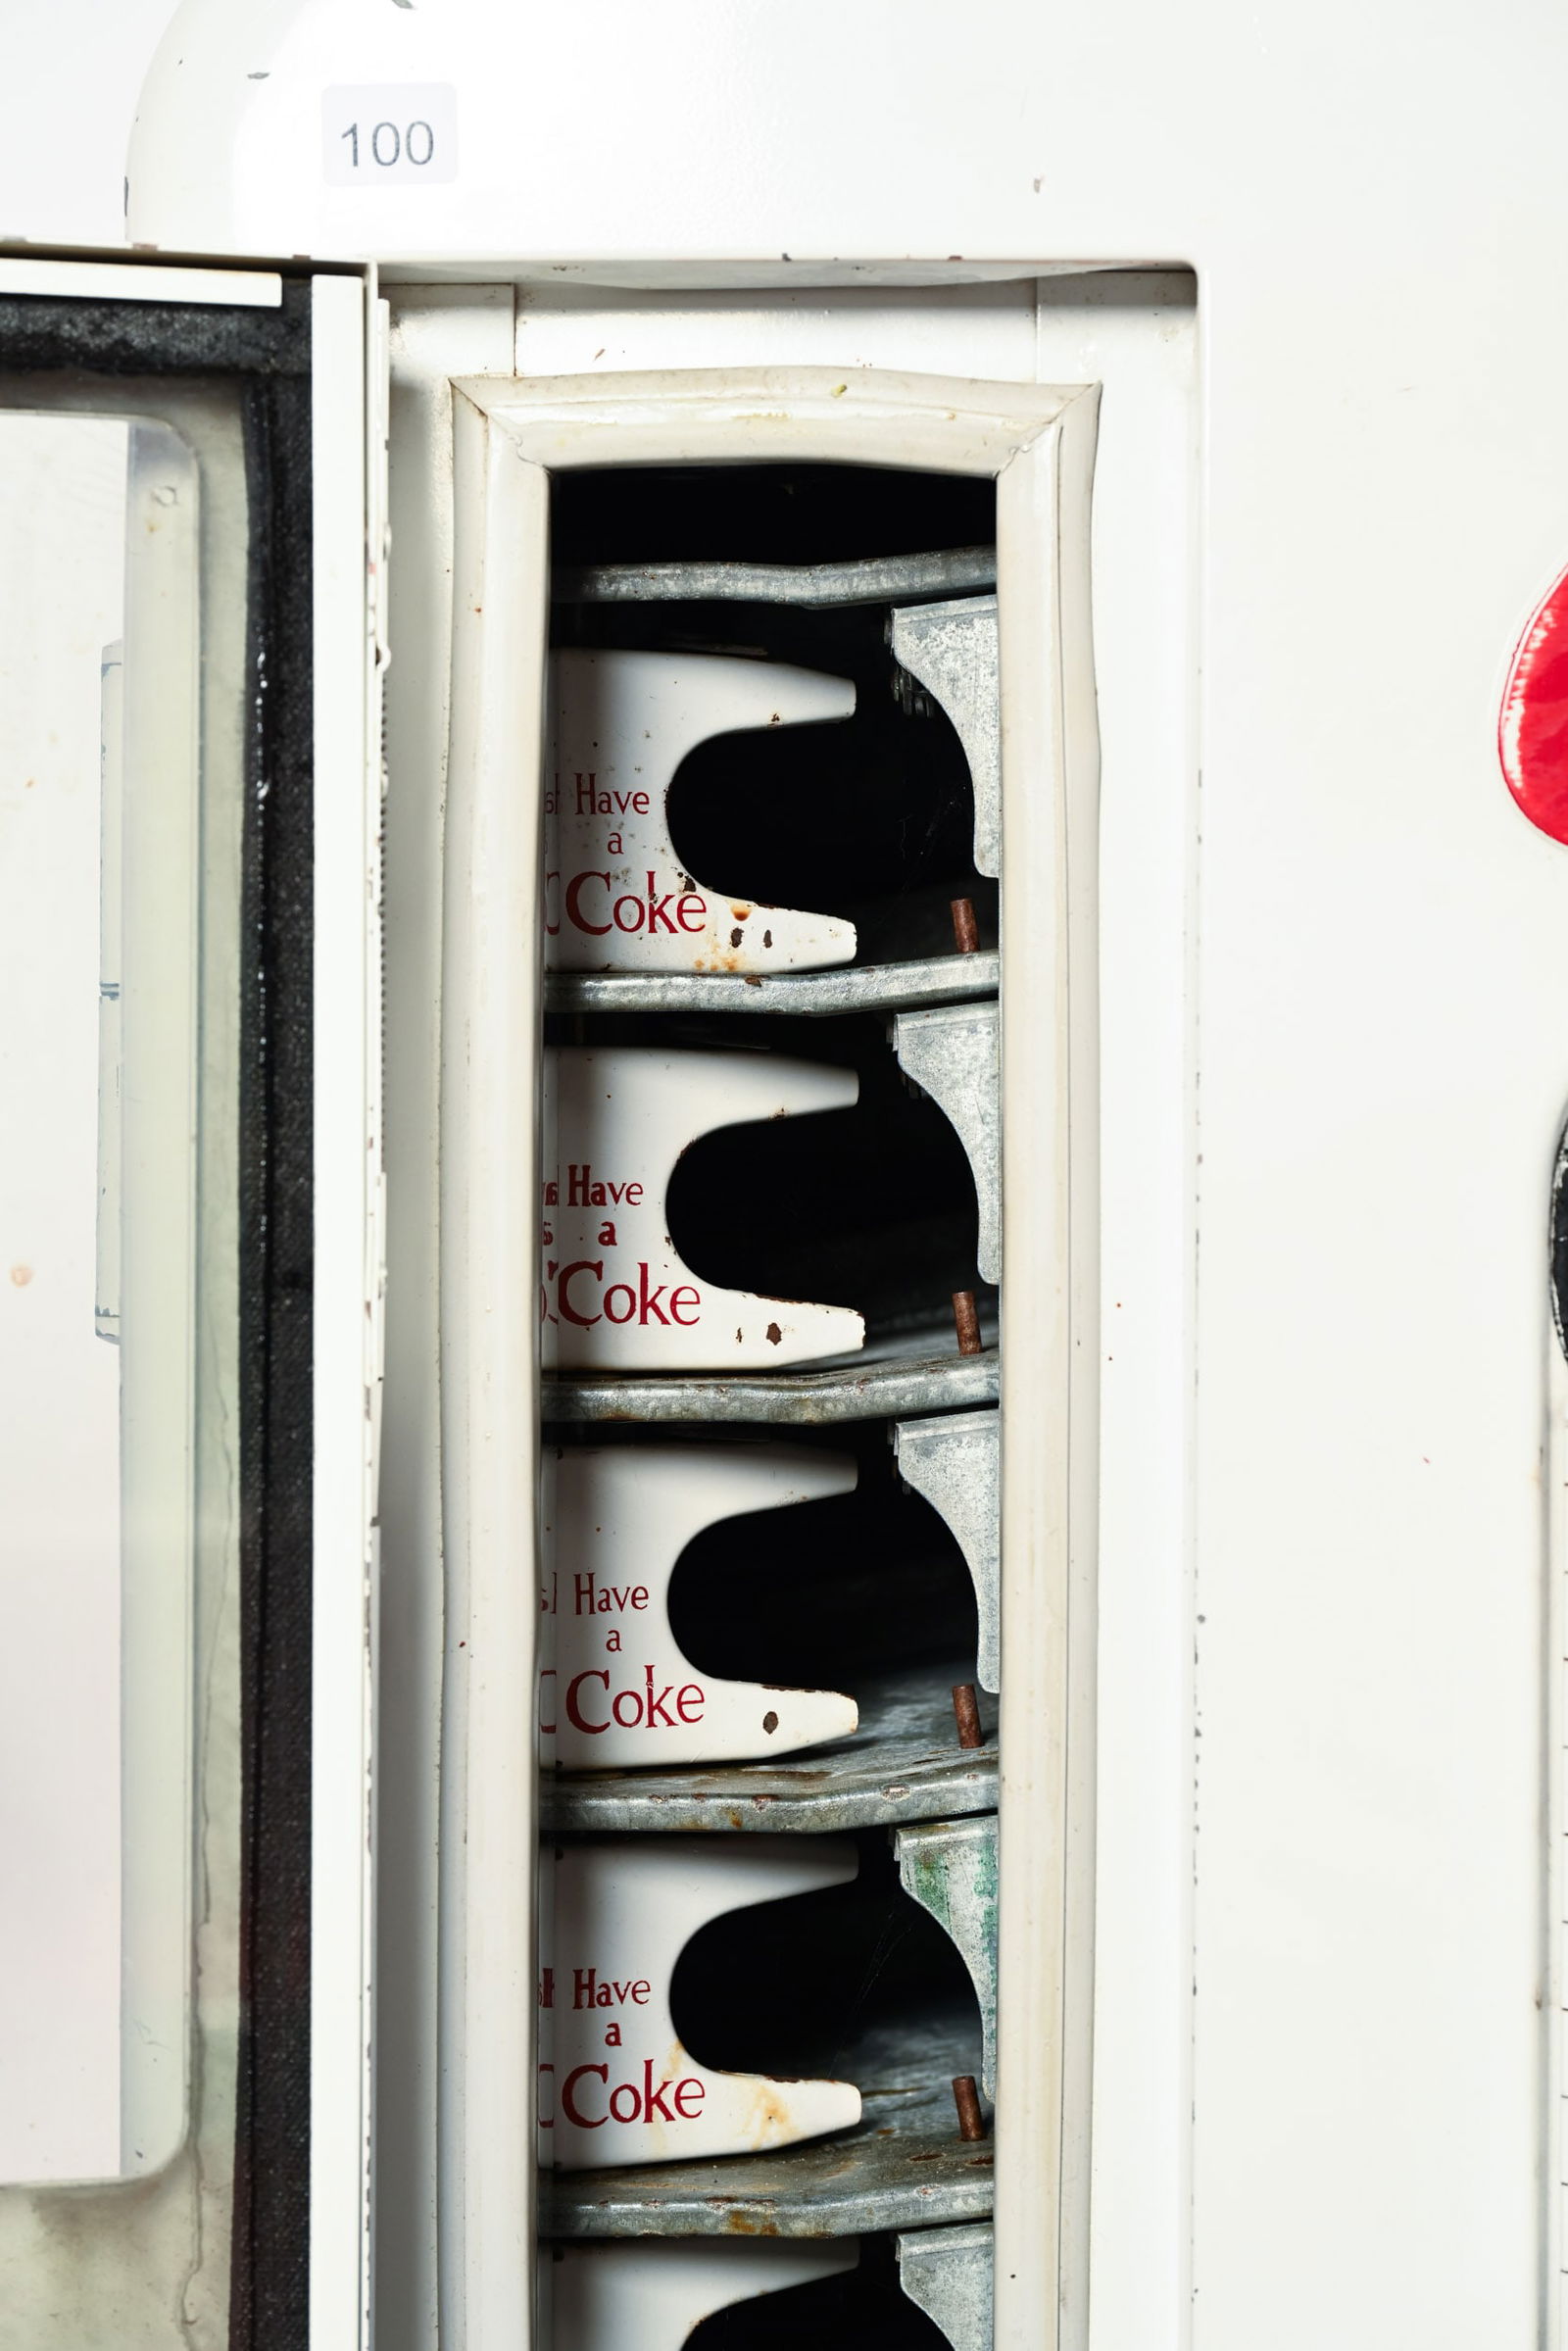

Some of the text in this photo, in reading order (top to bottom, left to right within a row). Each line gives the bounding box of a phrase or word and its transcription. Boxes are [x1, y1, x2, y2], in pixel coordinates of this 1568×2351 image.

[341, 121, 434, 167] 100
[574, 772, 650, 815] Have
[607, 832, 623, 855] a
[565, 870, 707, 935] Coke
[567, 1163, 644, 1207] Have
[598, 1221, 617, 1247] a
[557, 1260, 701, 1327] Coke
[574, 1572, 649, 1616] Have
[606, 1630, 622, 1652] a
[565, 1664, 706, 1735] Coke
[572, 1968, 651, 2010] Have
[605, 2022, 622, 2047] a
[561, 2059, 706, 2129] Coke
